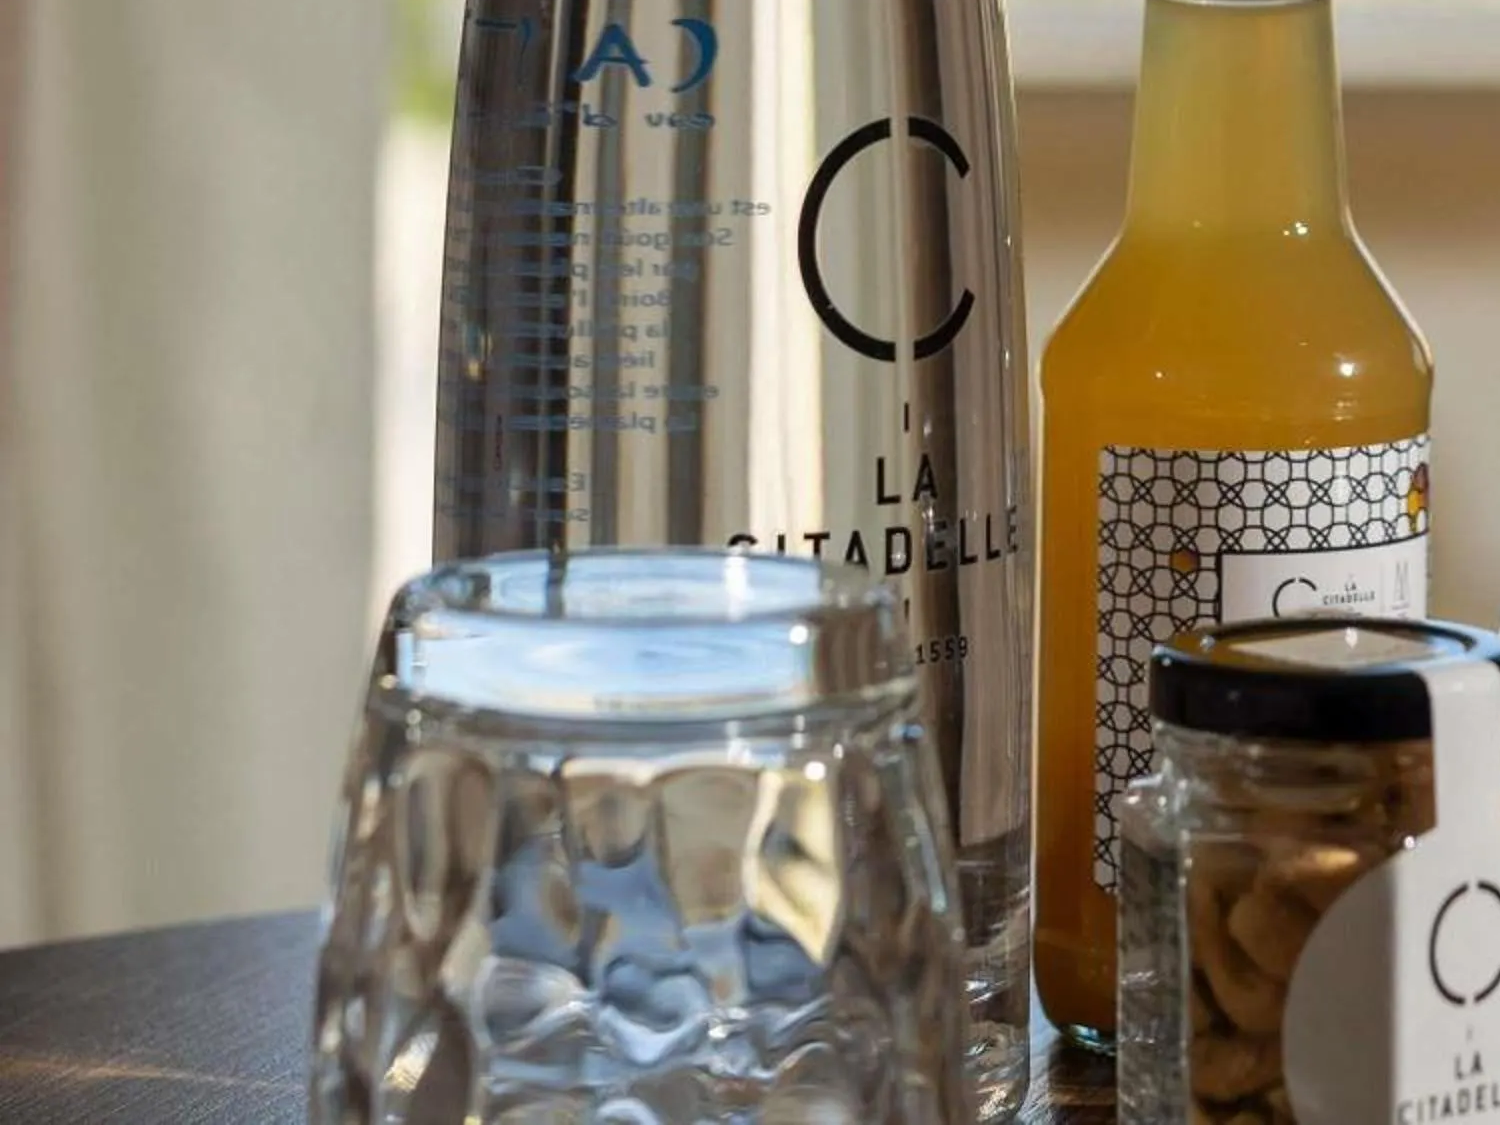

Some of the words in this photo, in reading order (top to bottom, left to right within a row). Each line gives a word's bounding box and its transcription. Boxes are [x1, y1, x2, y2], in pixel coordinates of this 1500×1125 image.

[875, 452, 940, 507] LA
[1322, 590, 1376, 606] CITADELLE
[1344, 582, 1357, 592] LA
[915, 637, 969, 668] 1559
[1453, 1050, 1484, 1080] LA
